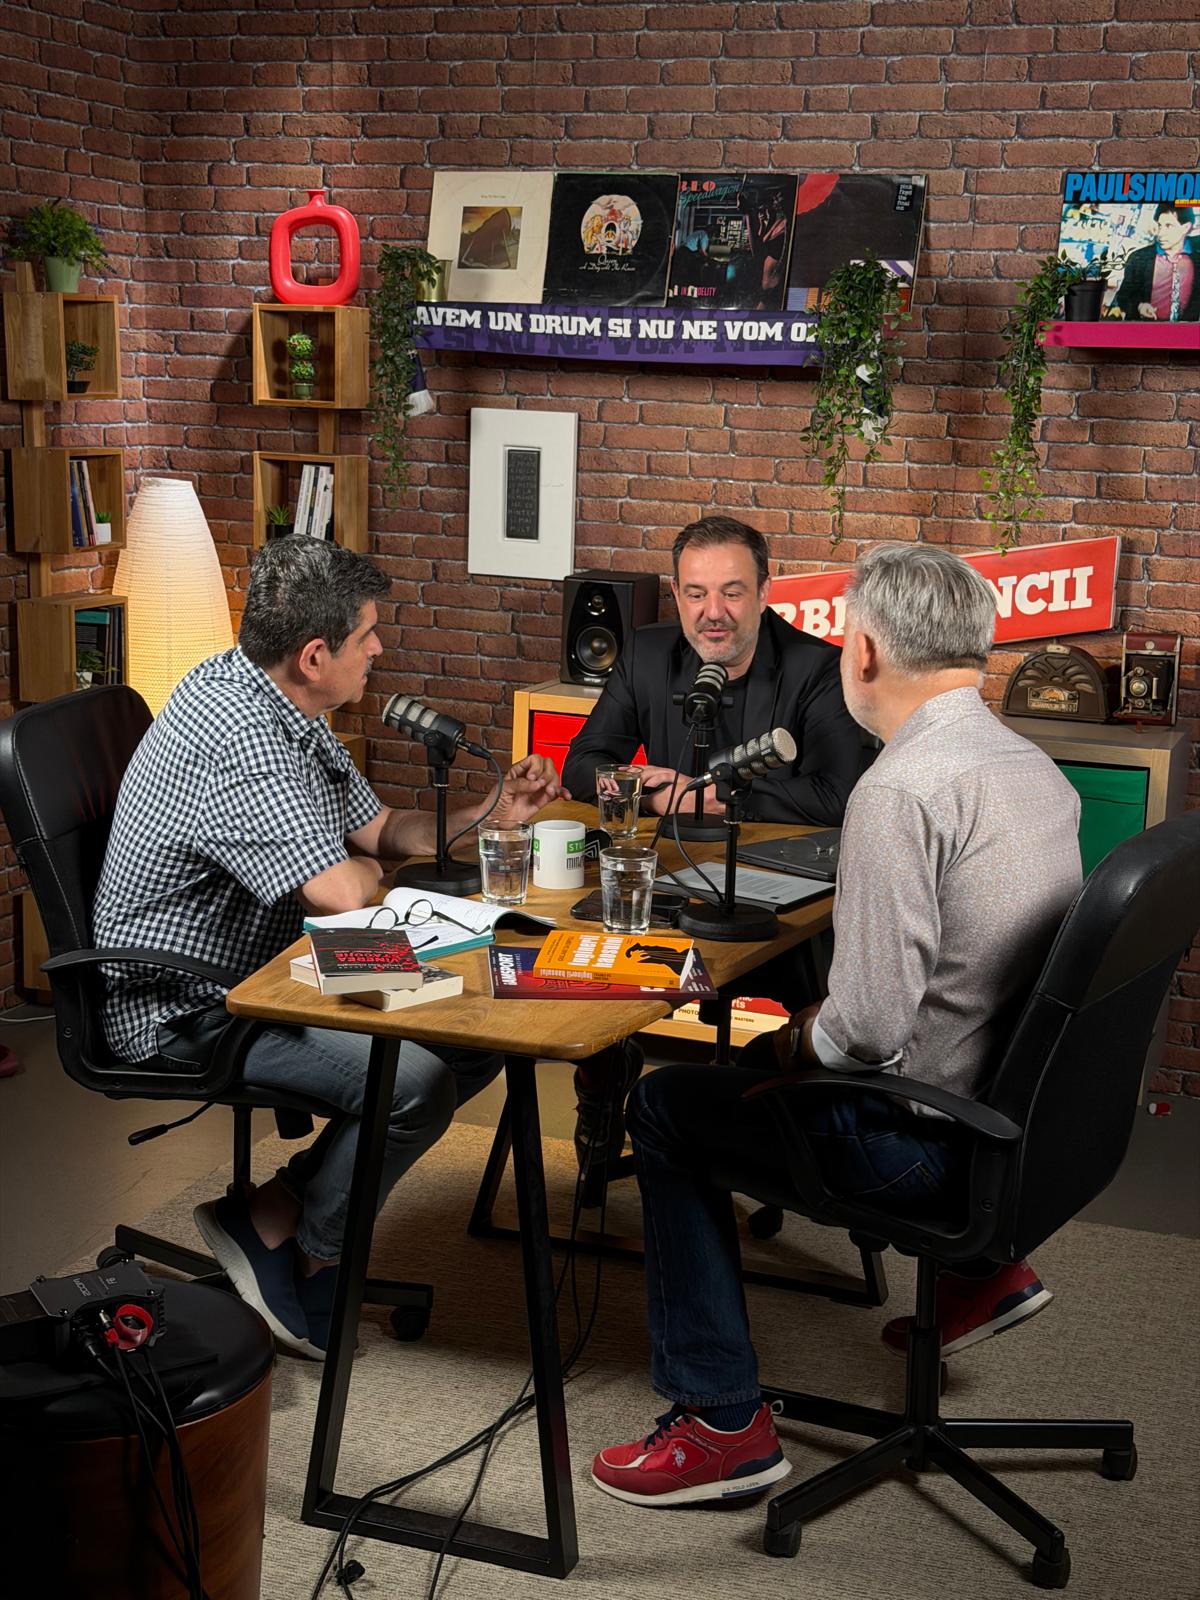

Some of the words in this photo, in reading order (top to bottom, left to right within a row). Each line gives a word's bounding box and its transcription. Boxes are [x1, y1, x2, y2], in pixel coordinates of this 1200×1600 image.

[1065, 173, 1128, 202] PAUL
[413, 306, 482, 329] AVEM
[488, 311, 523, 333] UN
[529, 314, 602, 337] DRUM
[608, 318, 632, 338] SI
[638, 319, 676, 340] NU
[682, 320, 717, 340] NE
[724, 321, 784, 342] VOM
